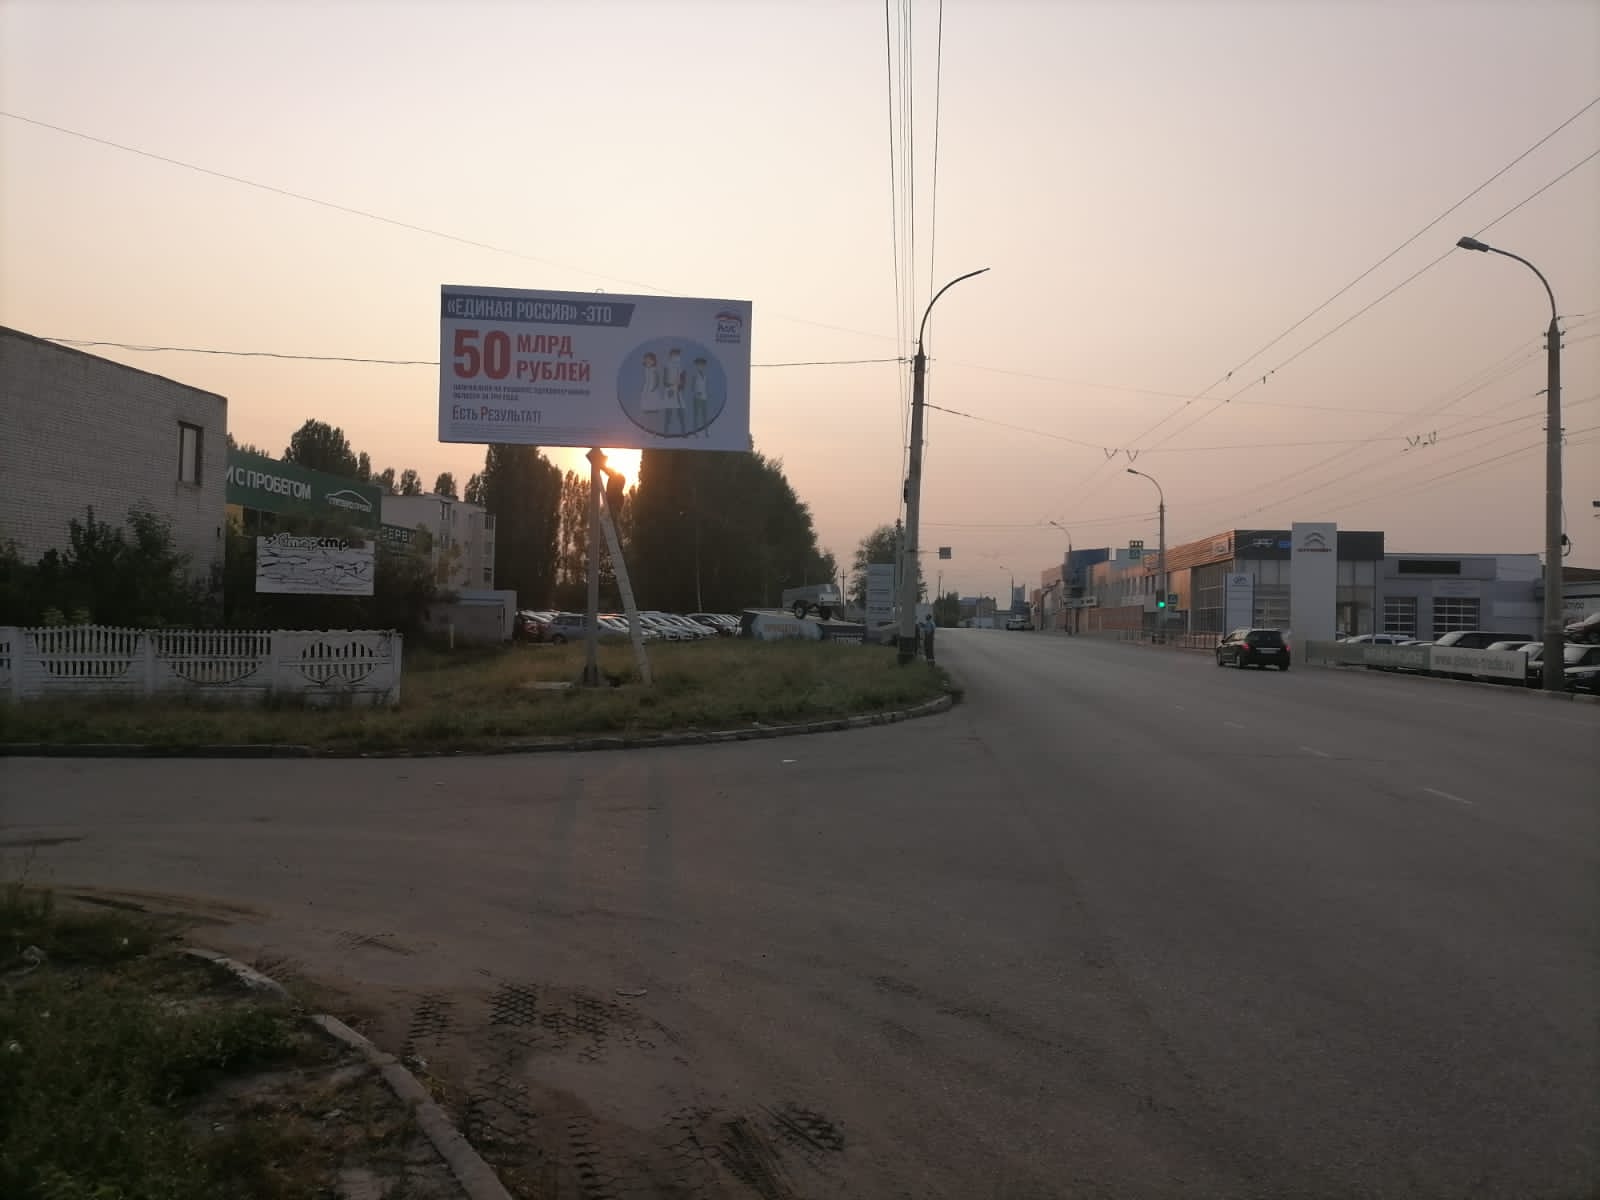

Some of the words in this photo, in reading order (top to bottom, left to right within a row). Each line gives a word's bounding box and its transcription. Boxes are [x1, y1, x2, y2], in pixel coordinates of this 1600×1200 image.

[448, 298, 513, 318] «ЕДИНАЯ
[516, 301, 578, 321] РОССИЯ»
[453, 328, 511, 380] 50
[517, 333, 573, 358] МЛРД
[516, 360, 591, 382] РУБЛЕЙ
[235, 468, 245, 485] С
[247, 470, 312, 501] ПРОБЕГОМ
